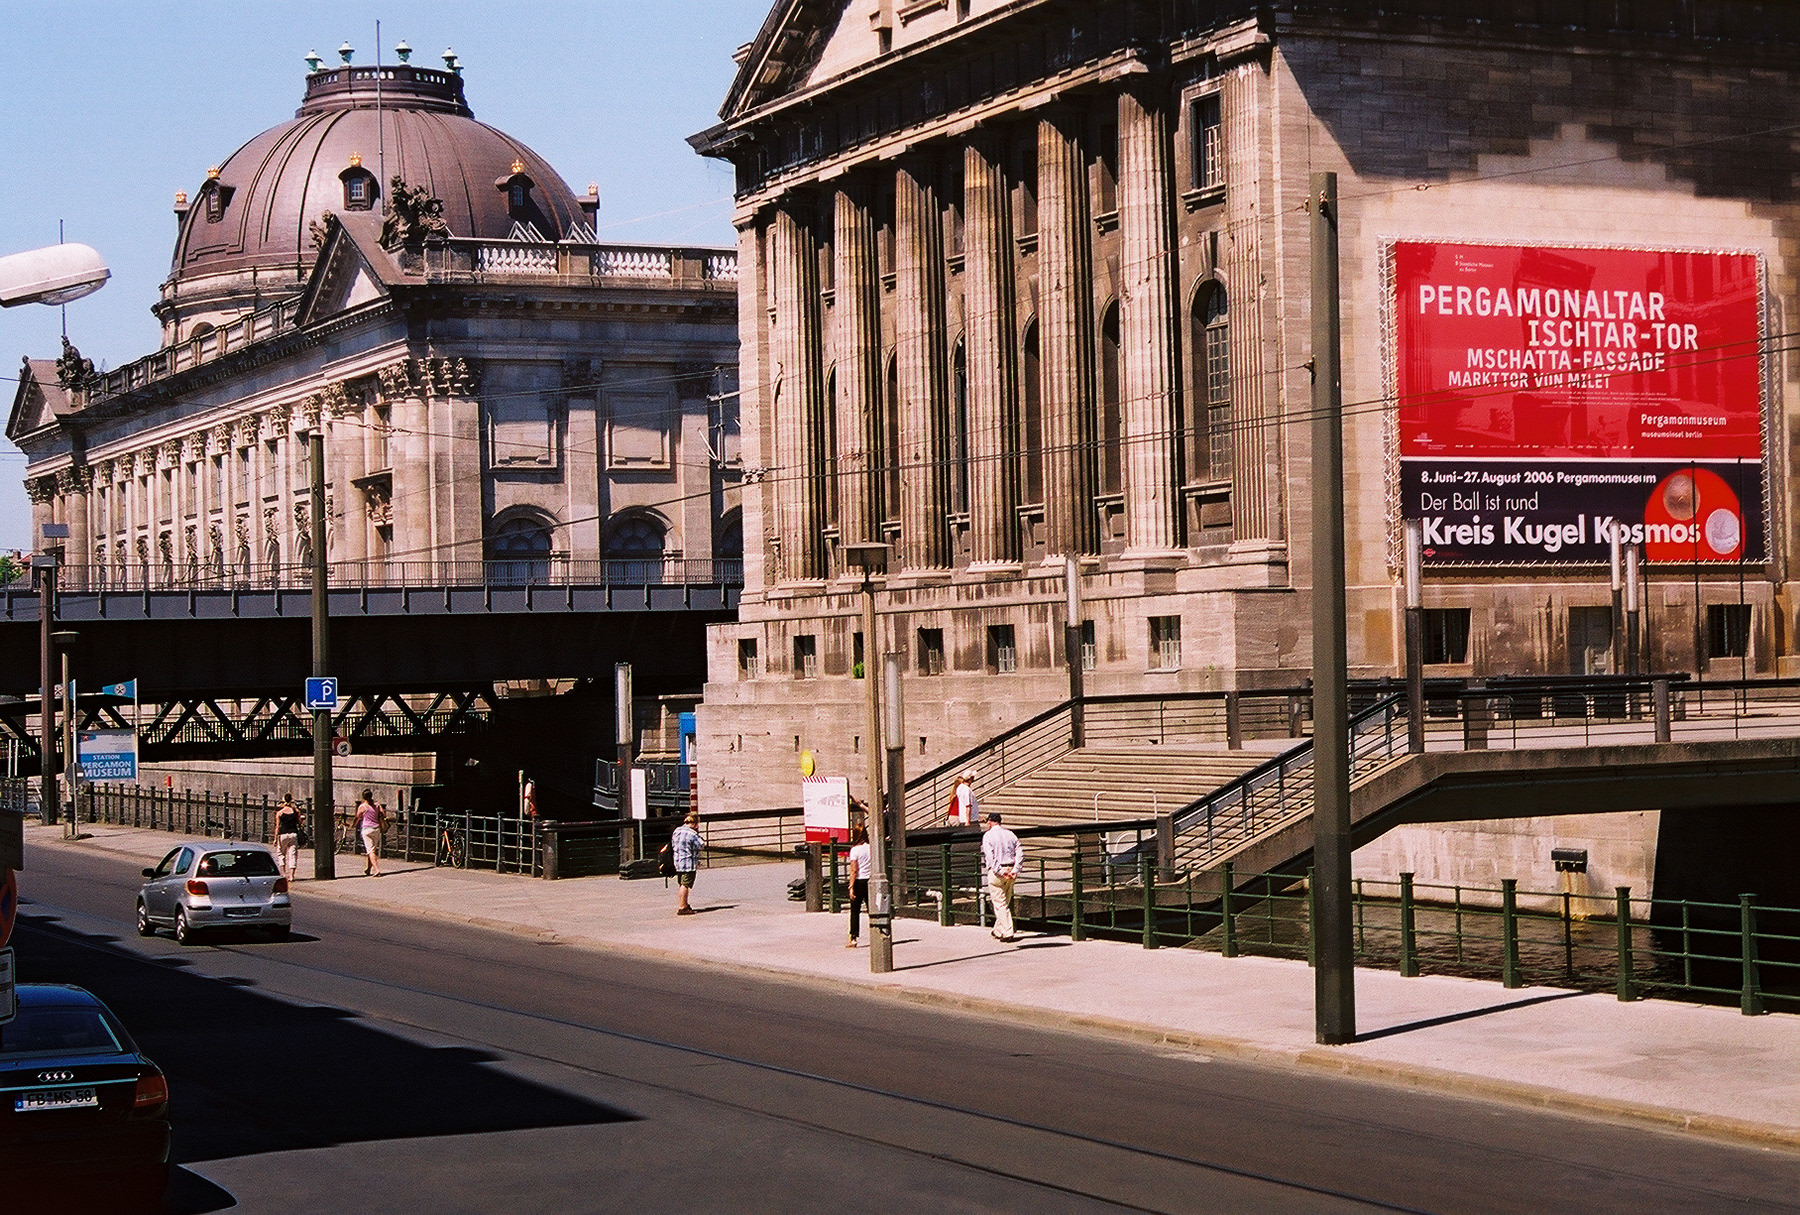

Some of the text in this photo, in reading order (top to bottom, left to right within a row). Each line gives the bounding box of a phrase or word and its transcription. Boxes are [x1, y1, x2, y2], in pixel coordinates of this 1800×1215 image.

[1419, 284, 1666, 321] PERGAMONALTAR
[1528, 320, 1699, 350] ISCHTAR-TOR
[1467, 348, 1666, 372] MSCHATTA-FASSADE
[1448, 370, 1529, 388] MARKTTOR
[1567, 373, 1611, 389] MILET
[1641, 413, 1727, 428] Pergamonmuseum
[1523, 471, 1555, 484] 2006
[1556, 471, 1657, 487] Pergamonmuseum
[1421, 490, 1539, 511] Der Ball ist rund
[1422, 513, 1702, 553] Kreis Kugel Kosmos
[322, 685, 333, 701] P
[81, 760, 132, 769] PERGAMON
[84, 768, 132, 778] MUSEUM
[75, 1089, 92, 1103] 58
